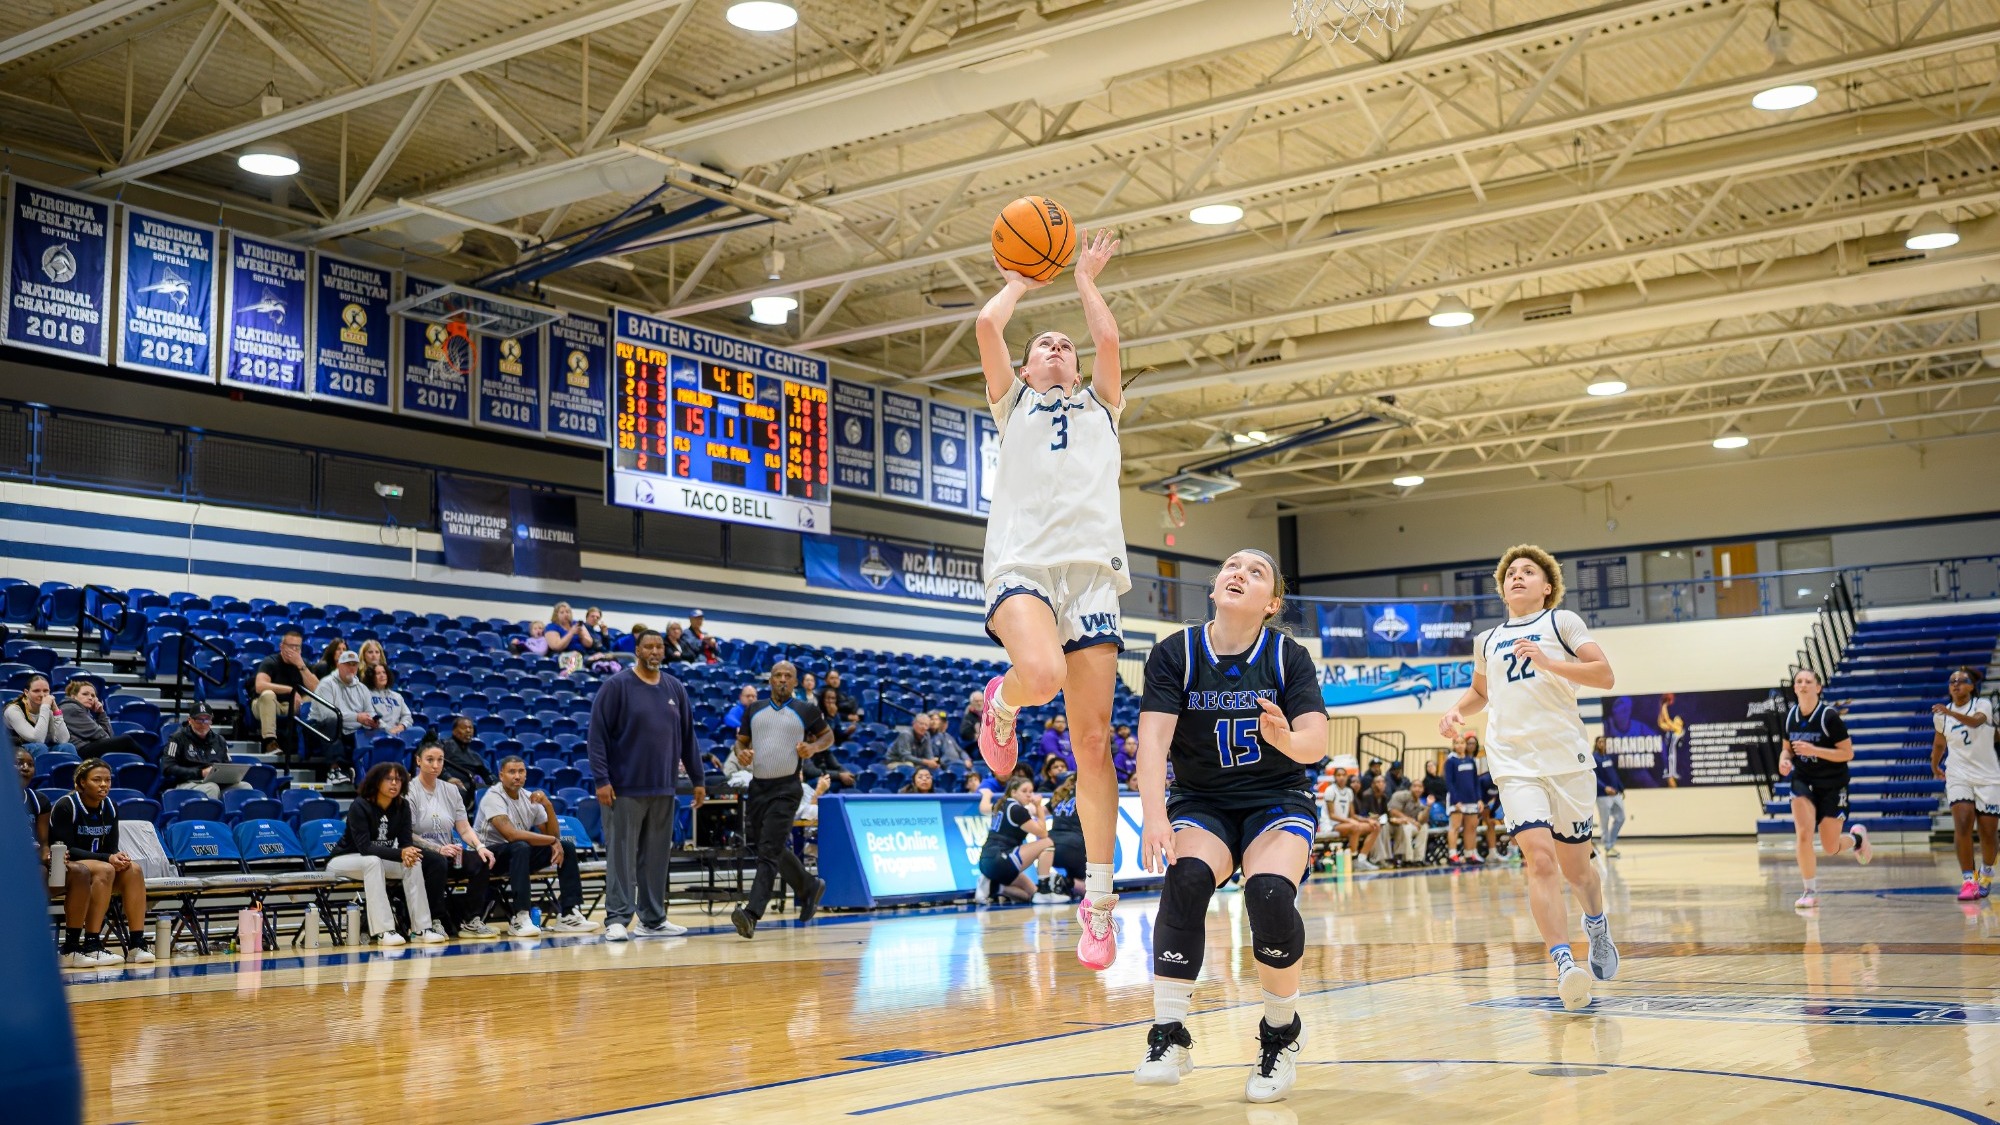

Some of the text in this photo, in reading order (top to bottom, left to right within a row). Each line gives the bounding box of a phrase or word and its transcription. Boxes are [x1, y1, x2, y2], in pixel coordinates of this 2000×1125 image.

[30, 192, 95, 221] VIRGINIA
[20, 204, 104, 237] WESLEYAN
[41, 226, 80, 242] SOFTBALL
[142, 220, 203, 246] VIRGINIA
[133, 232, 209, 262] WESLEYAN
[241, 242, 296, 267] VIRGINIA
[152, 252, 189, 268] SOFTBALL
[235, 255, 306, 281] WESLEYAN
[252, 273, 286, 288] SOFTBALL
[330, 263, 382, 286] VIRGINIA
[21, 280, 94, 309] NATIONAL
[322, 274, 388, 300] WESLEYAN
[14, 294, 100, 325] CHAMPIONS
[136, 304, 202, 331] NATIONAL
[26, 316, 85, 345] 2018
[129, 318, 207, 346] CHAMPIONS
[235, 325, 300, 349] NATIONAL
[552, 325, 605, 348] WESLEYAN
[141, 338, 194, 367] 2021
[234, 338, 304, 363] RUNNER-UP
[321, 348, 356, 363] REGULAR
[342, 343, 365, 356] FINAL
[628, 316, 819, 380] BATTEN STUDENT CENTER
[649, 349, 667, 367] PTS
[240, 357, 294, 383] 2025
[318, 356, 338, 368] POLL
[338, 360, 370, 374] RANKED
[625, 360, 666, 384] 0 1 2
[329, 372, 375, 396] 2016
[625, 377, 666, 402] 2 0 3
[713, 366, 754, 400] 4:16
[417, 387, 457, 411] 2017
[677, 388, 713, 408] MARLINS
[811, 387, 828, 404] PTS
[491, 400, 530, 423] 2018
[627, 396, 666, 419] 3 0 4
[718, 403, 739, 417] PERIOD
[793, 397, 801, 414] 3
[801, 399, 811, 416] 0
[818, 403, 828, 419] 0
[559, 412, 597, 434] 2019
[618, 412, 666, 438] 22 0 0
[686, 407, 705, 436] 15
[728, 418, 734, 438] 1
[802, 415, 812, 432] 0
[818, 420, 827, 436] 5
[1050, 414, 1068, 451] 3
[619, 430, 666, 456] 30 1 6
[673, 436, 691, 452] FLS
[767, 422, 780, 450] 5
[789, 430, 828, 452] 14 1 0
[637, 452, 647, 470] 2
[679, 454, 690, 477] 2
[764, 452, 781, 469] FLS
[789, 447, 828, 468] 15 0 0
[774, 472, 781, 492] 1
[786, 462, 828, 485] 24 0 0
[841, 468, 869, 486] 1984
[806, 483, 812, 497] 1
[890, 476, 918, 495] 1989
[937, 486, 963, 503] 2015
[682, 488, 773, 520] TACO BELL
[443, 510, 507, 529] CHAMPIONS
[448, 522, 471, 537] WIN
[473, 526, 502, 539] HERE
[529, 527, 575, 544] VOLLEYBALL
[903, 552, 978, 580] NCAA DIII
[1354, 663, 1391, 686] THE
[1504, 653, 1535, 683] 22
[1187, 688, 1277, 710] REGENT
[1213, 717, 1262, 768] 15
[1605, 735, 1663, 754] BRANDON
[1961, 730, 1972, 746] 2
[1618, 753, 1655, 769] ADAIR
[872, 818, 890, 827] NEWS
[896, 818, 917, 826] WORLD
[917, 817, 938, 826] REPORT
[191, 845, 218, 856] VWU
[258, 843, 285, 855] VWU
[866, 831, 896, 852] Best
[896, 830, 939, 851] Online
[872, 853, 937, 879] Programs
